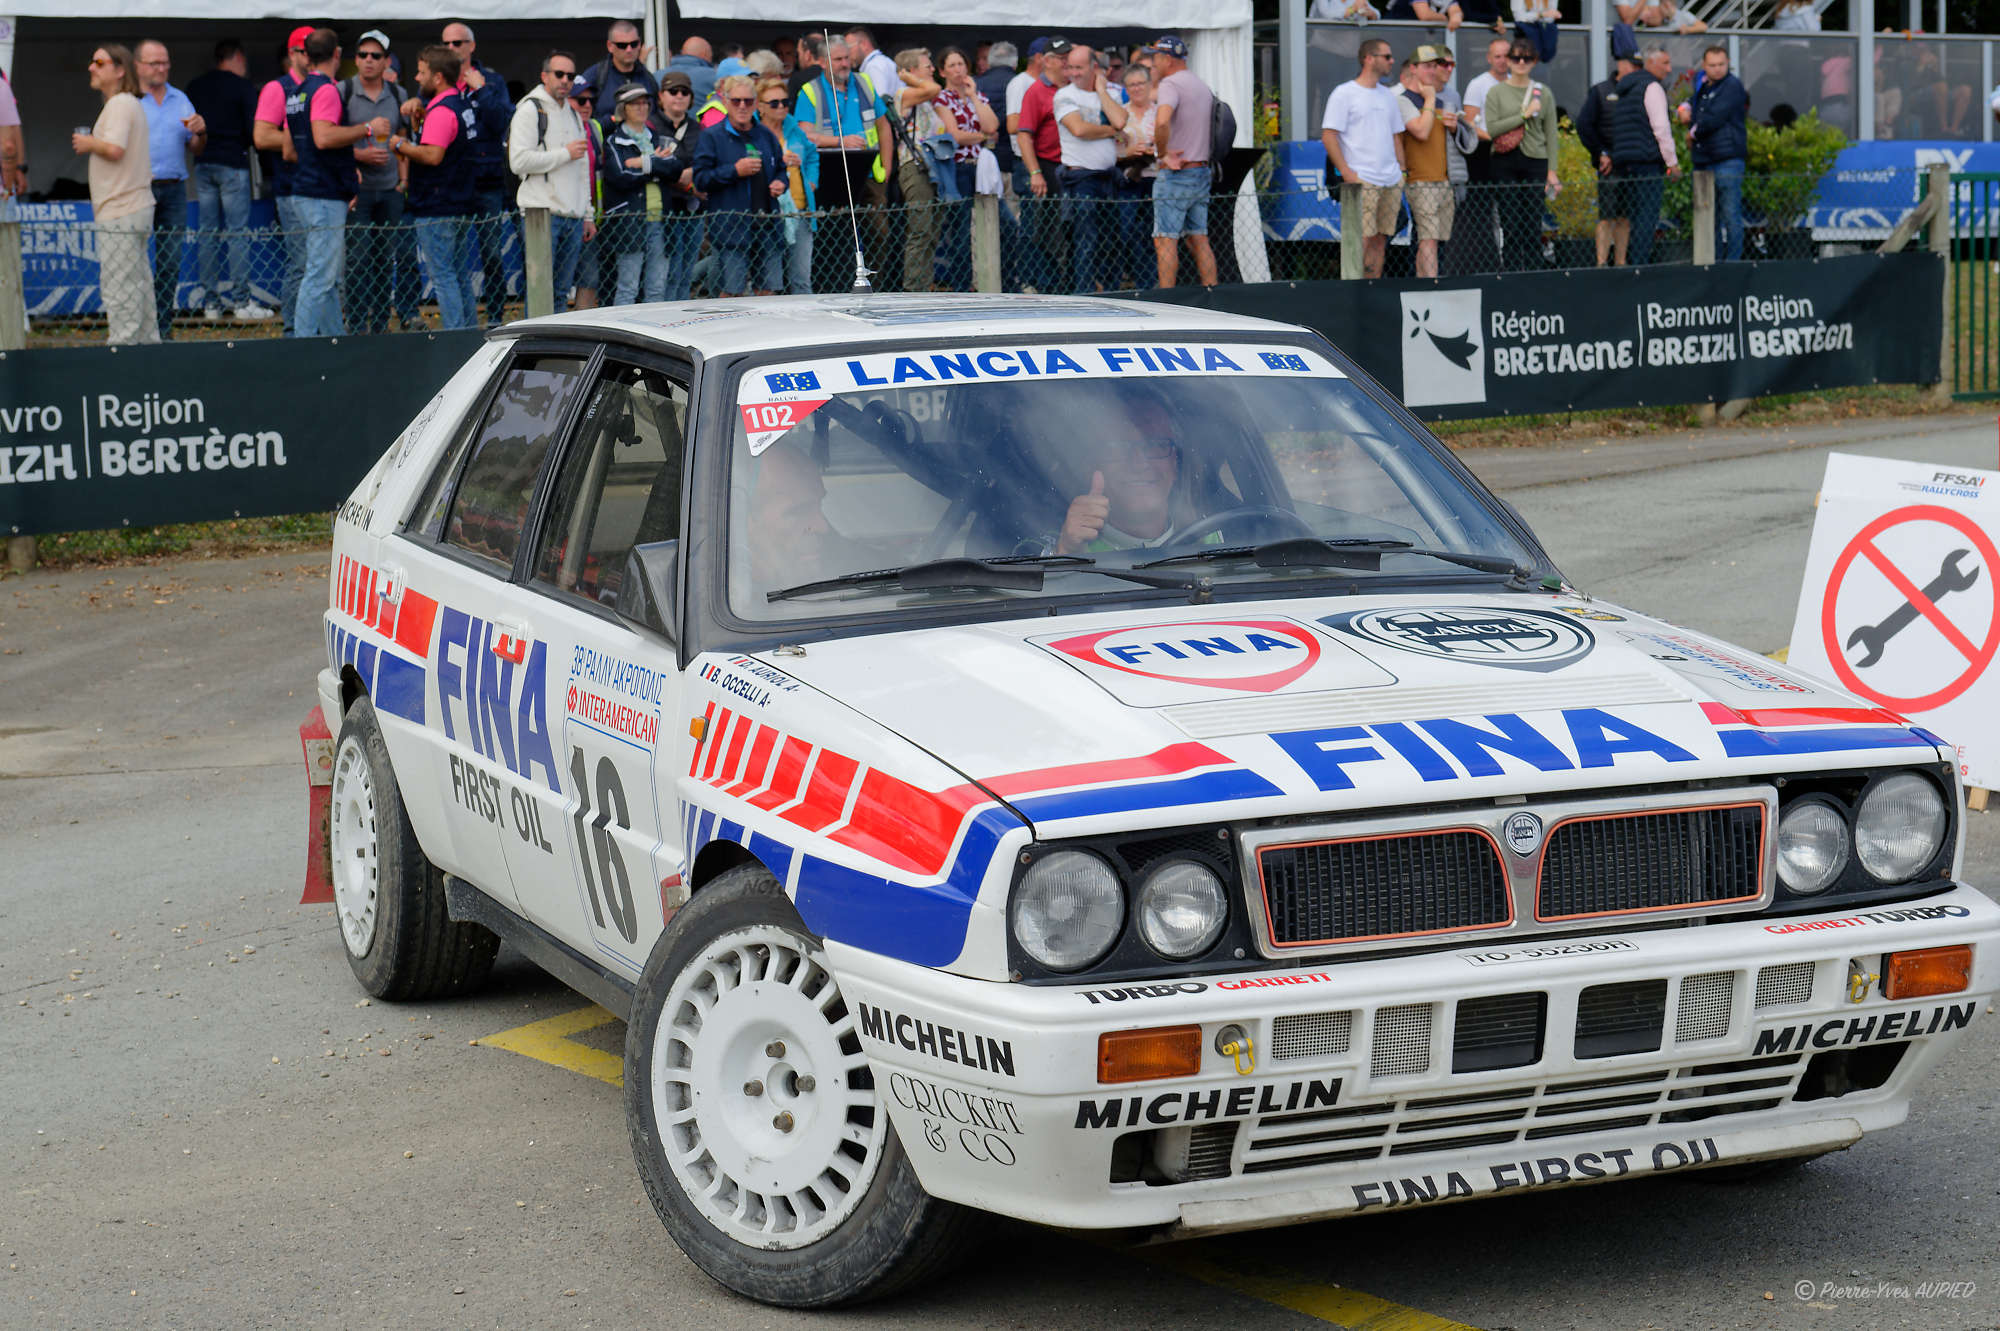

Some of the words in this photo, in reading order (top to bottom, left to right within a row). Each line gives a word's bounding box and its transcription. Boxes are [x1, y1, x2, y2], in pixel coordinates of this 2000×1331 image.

[1491, 310, 1564, 343] Région
[1647, 303, 1732, 329] Rannvro
[1745, 295, 1814, 325] Rejion
[847, 349, 1085, 387] LANCIA
[1099, 346, 1246, 374] FINA
[1494, 340, 1633, 376] BRETAGNE
[1648, 333, 1736, 366] BREIZH
[0, 405, 62, 433] vro
[99, 393, 204, 434] Rejion
[745, 405, 796, 429] 102
[1921, 485, 1980, 499] RALLYCROSS
[1932, 472, 1978, 487] FFSA
[1412, 623, 1529, 637] LANCIA
[1104, 633, 1301, 664] FINA
[438, 606, 562, 795] FINA
[722, 674, 761, 702] OCCELLI
[579, 690, 658, 745] INTERAMERICAN
[1269, 707, 1700, 792] FINA
[449, 753, 504, 828] FIRST
[511, 786, 553, 854] OIL
[1764, 917, 1867, 935] GARRETT
[1856, 905, 1970, 924] TURBO
[1076, 982, 1208, 1004] TURBO
[1216, 972, 1333, 990] GARRETT
[859, 1002, 1016, 1077] MICHELIN
[1753, 1002, 1976, 1056] MICHELIN
[890, 1072, 1025, 1135] CRICKET
[1074, 1077, 1343, 1129] MICHELIN
[923, 1118, 947, 1153] &
[959, 1128, 1016, 1166] CO
[1351, 1171, 1473, 1211] FINA
[1489, 1149, 1633, 1192] FIRST
